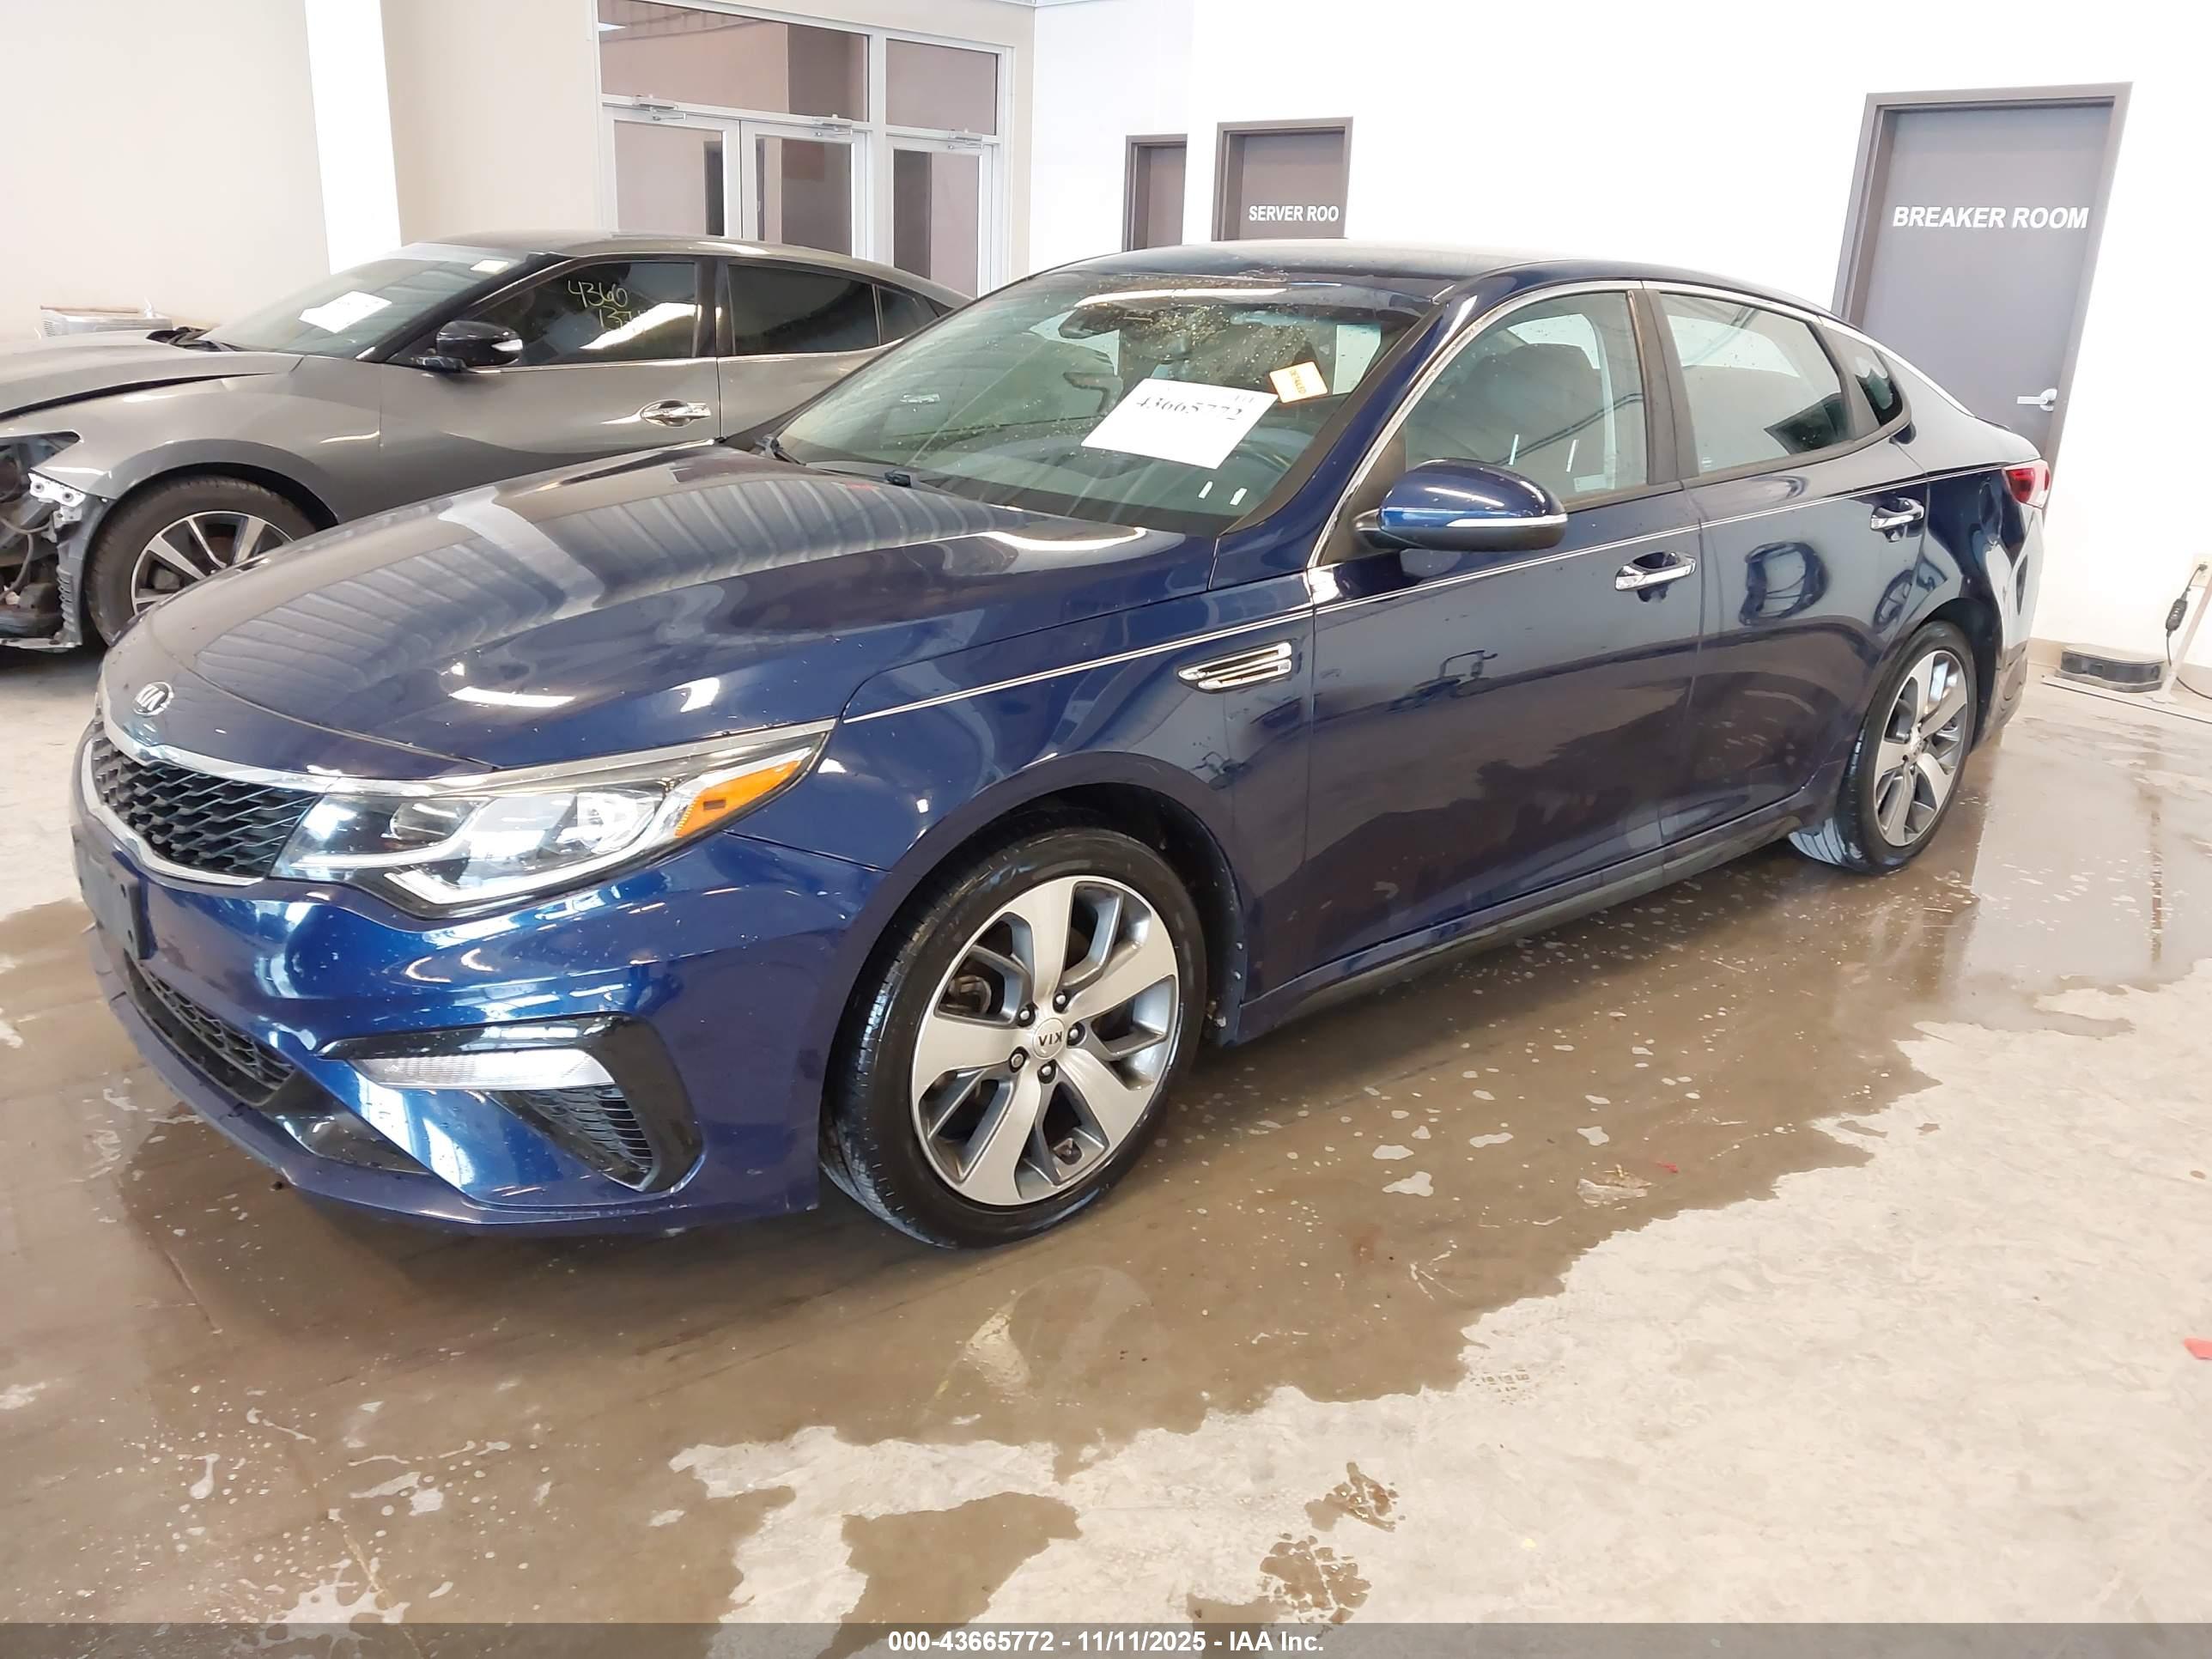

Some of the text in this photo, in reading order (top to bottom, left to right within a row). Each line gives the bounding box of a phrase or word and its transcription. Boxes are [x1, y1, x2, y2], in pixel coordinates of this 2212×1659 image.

[1249, 205, 1340, 222] SERVER ROO
[1893, 206, 2089, 229] BREAKER ROOM
[568, 280, 629, 308] 4360
[1038, 1030, 1063, 1047] KIA
